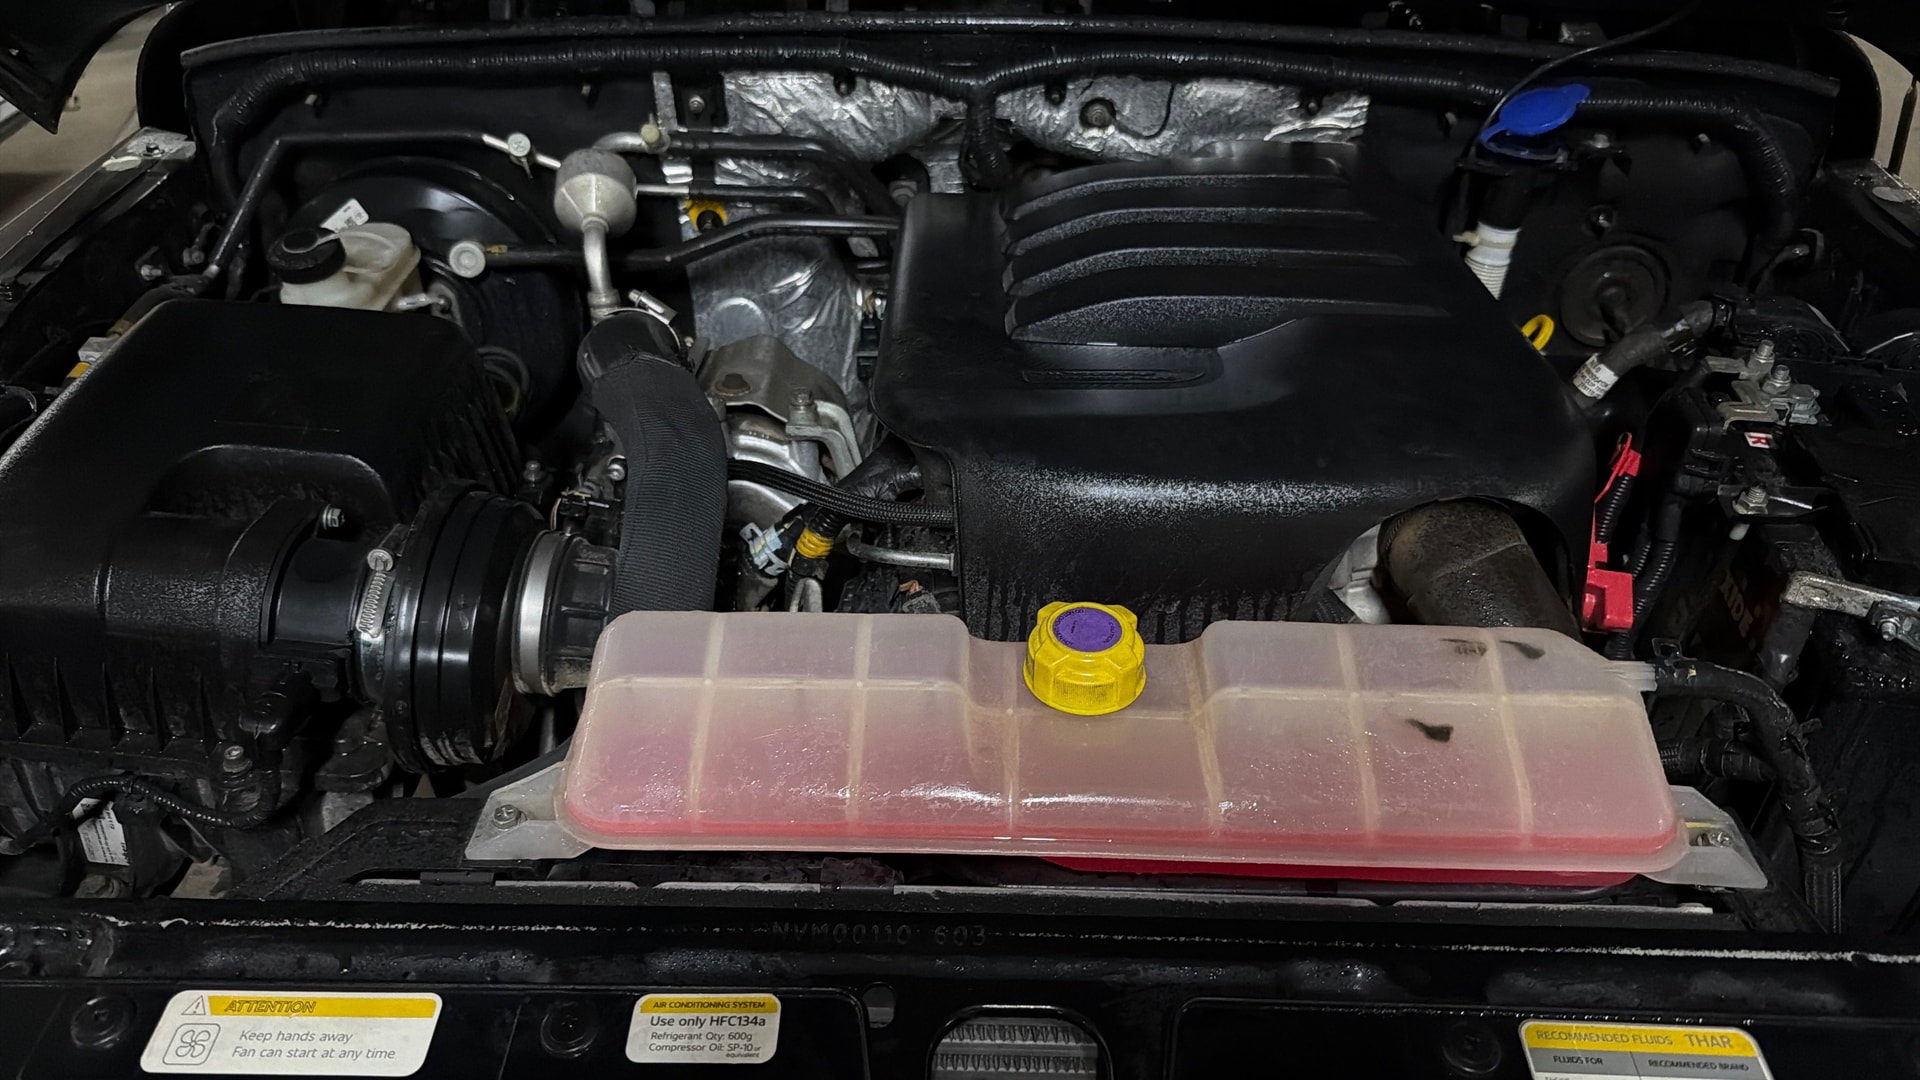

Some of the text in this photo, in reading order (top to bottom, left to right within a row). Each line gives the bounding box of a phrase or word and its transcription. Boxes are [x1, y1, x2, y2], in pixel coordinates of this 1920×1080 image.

[225, 1000, 316, 1013] ATTENTION
[650, 1016, 766, 1028] Use only HFC134a
[239, 1030, 352, 1044] Keep hands away
[651, 1032, 752, 1042] Refrigerant Qty: 600g
[1536, 1030, 1734, 1048] RECOMMENDED FLUIDS THAR
[232, 1046, 396, 1060] Fan can start at any time
[648, 1044, 705, 1052] Compressor
[727, 1044, 753, 1052] SP-10
[1553, 1056, 1603, 1065] FLUIDS FOR
[1648, 1060, 1718, 1070] RECOMMENDED
